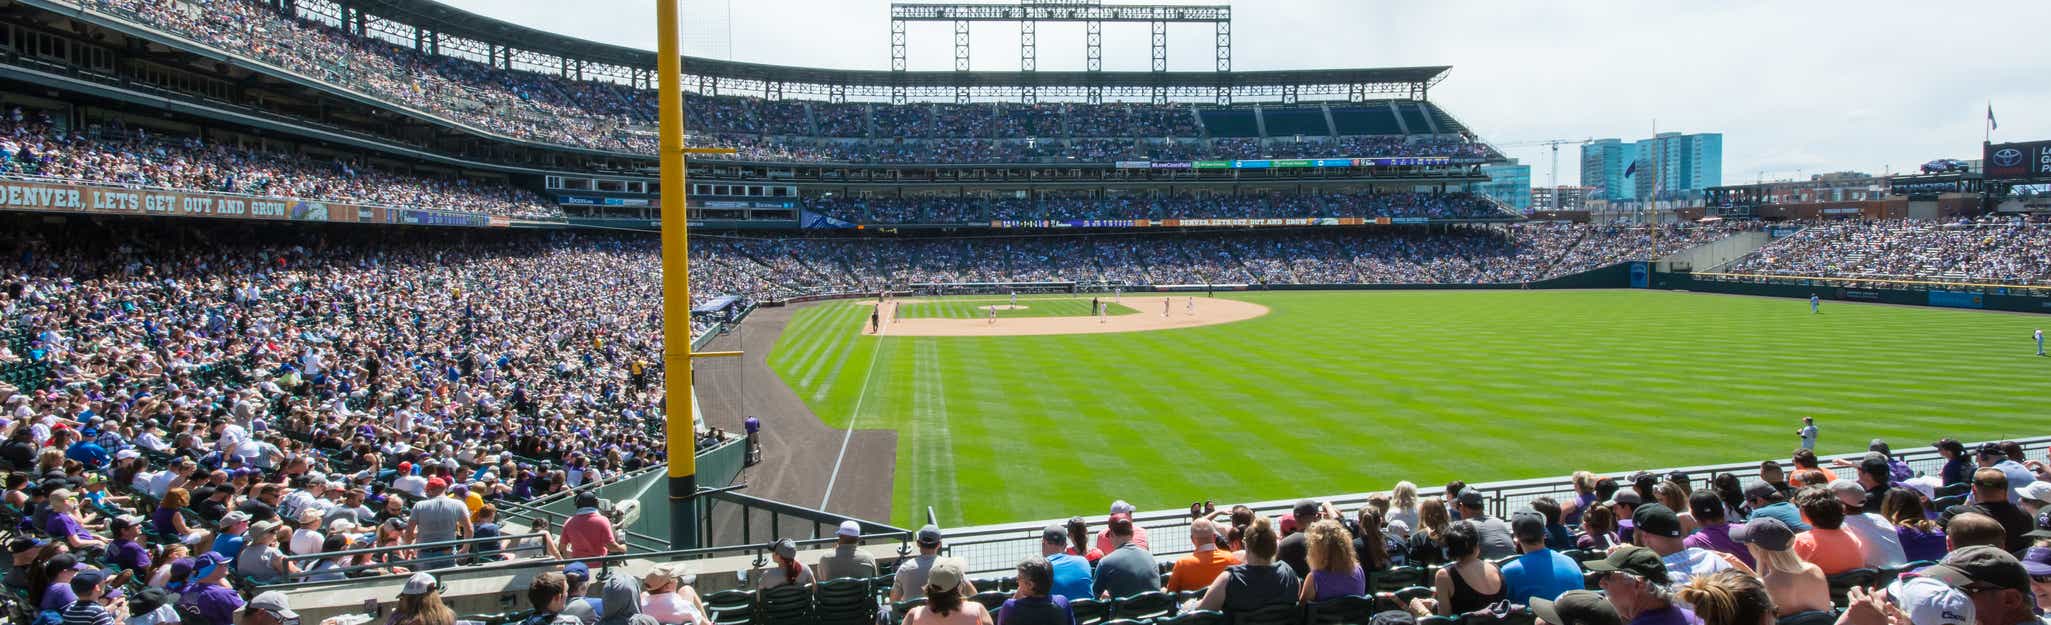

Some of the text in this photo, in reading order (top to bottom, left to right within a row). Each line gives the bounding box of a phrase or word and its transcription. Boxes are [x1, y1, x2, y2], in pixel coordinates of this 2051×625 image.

[93, 191, 140, 210] LETS
[145, 194, 176, 212] GET
[183, 197, 213, 213] OUT
[217, 199, 245, 215] AND
[251, 201, 286, 216] GROW
